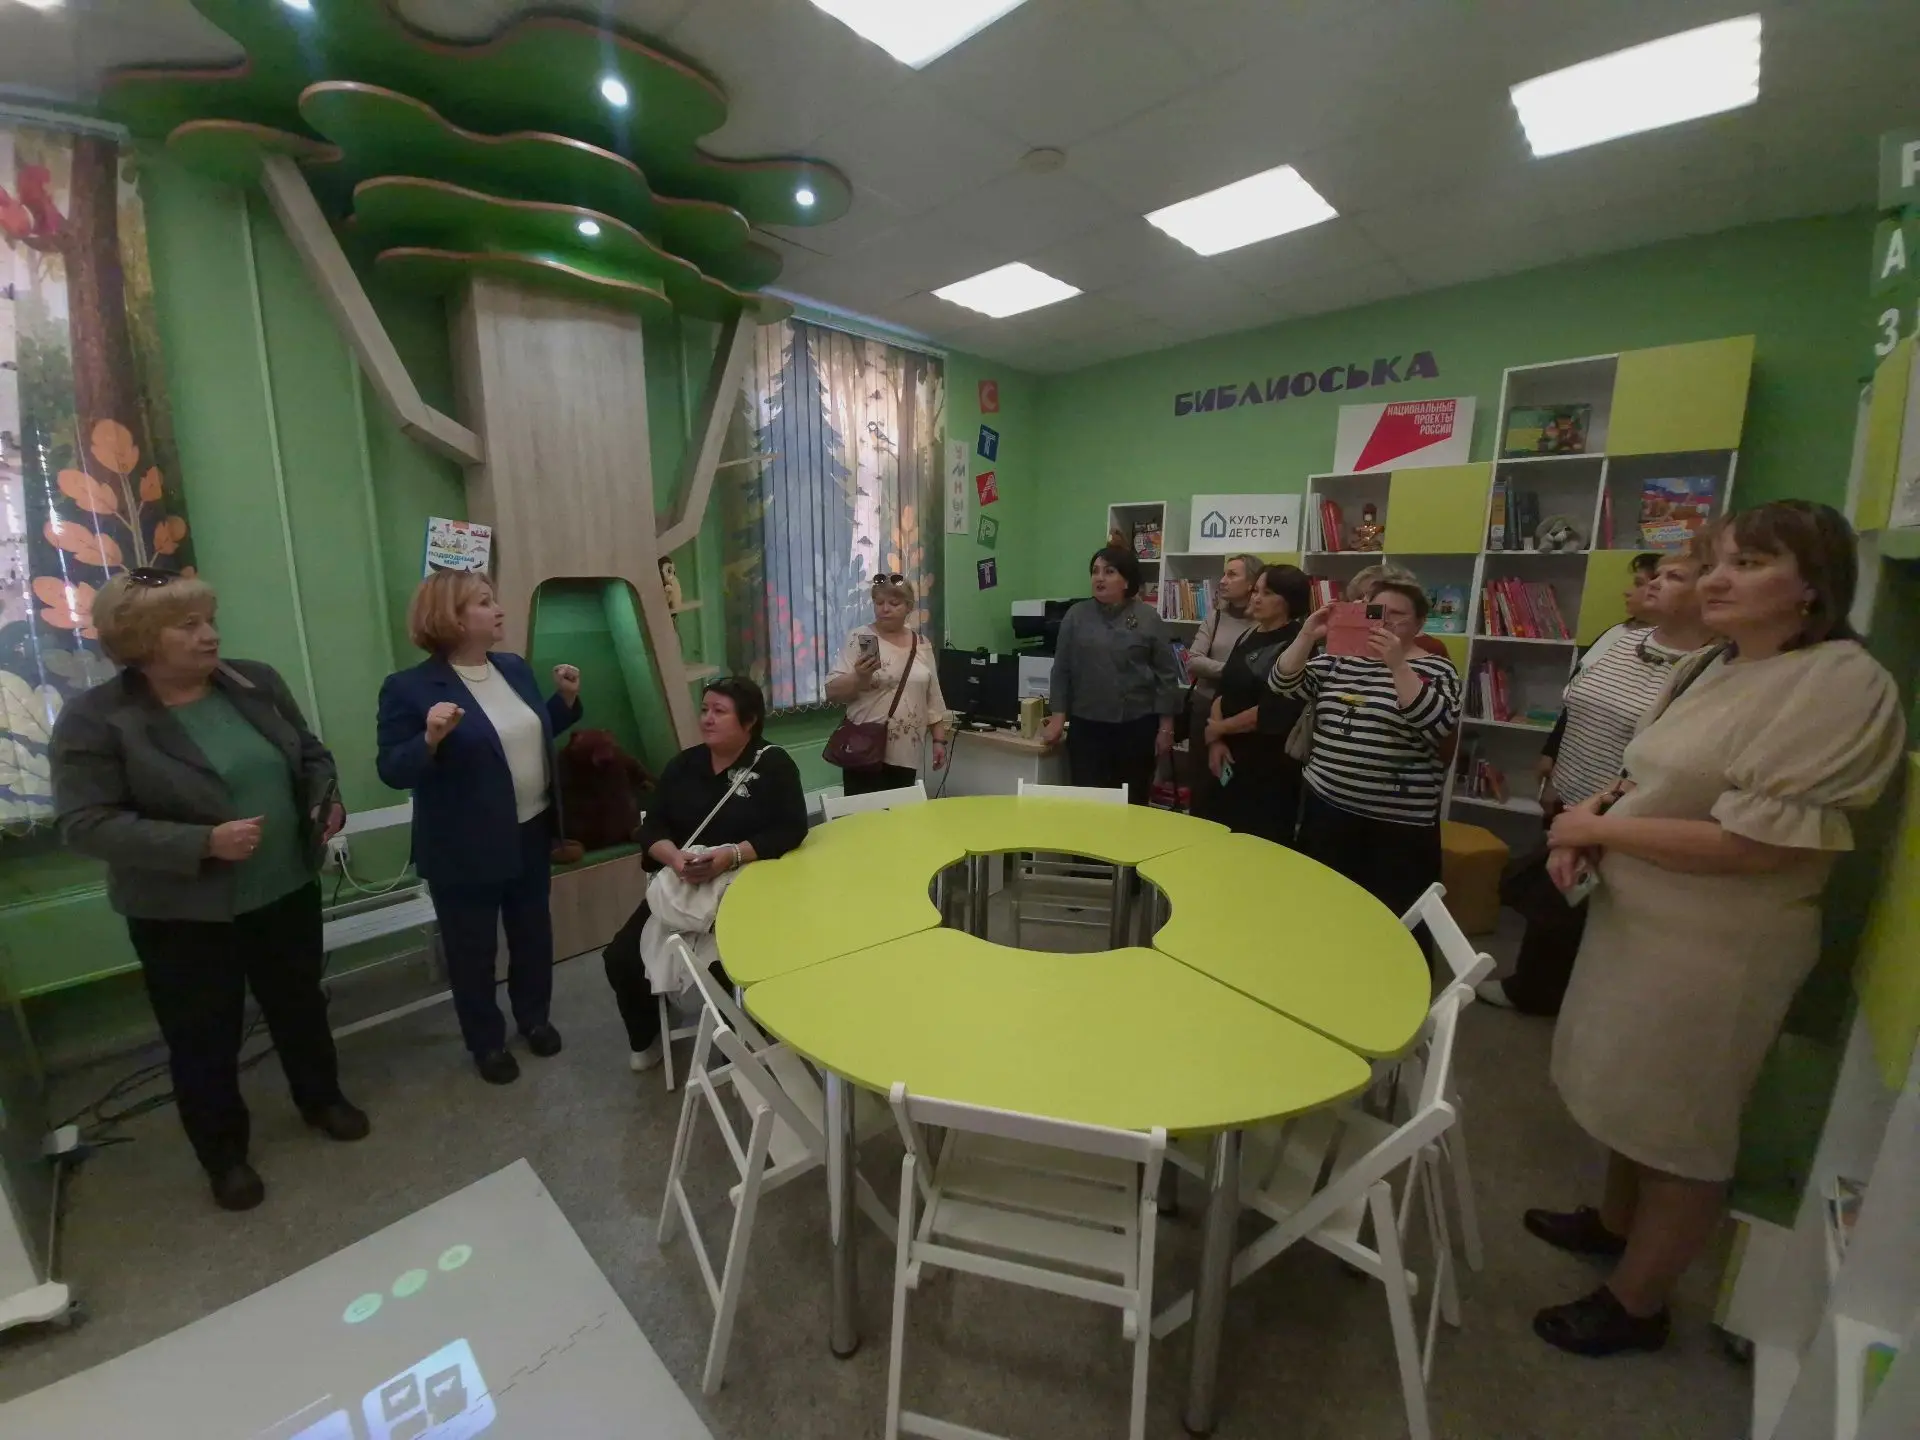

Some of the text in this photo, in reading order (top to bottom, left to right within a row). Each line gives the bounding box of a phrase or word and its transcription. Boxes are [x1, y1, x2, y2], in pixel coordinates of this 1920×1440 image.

[1174, 351, 1440, 417] БИБЛИОСЬКА
[1387, 400, 1456, 416] НАЦИОНАЛЬНЫЕ
[1414, 412, 1453, 425] ПРОЕКТЫ
[1420, 423, 1452, 435] РОССИИ
[1229, 515, 1288, 525] КУЛЬТУРА
[1228, 528, 1280, 538] ДЕТСТВА
